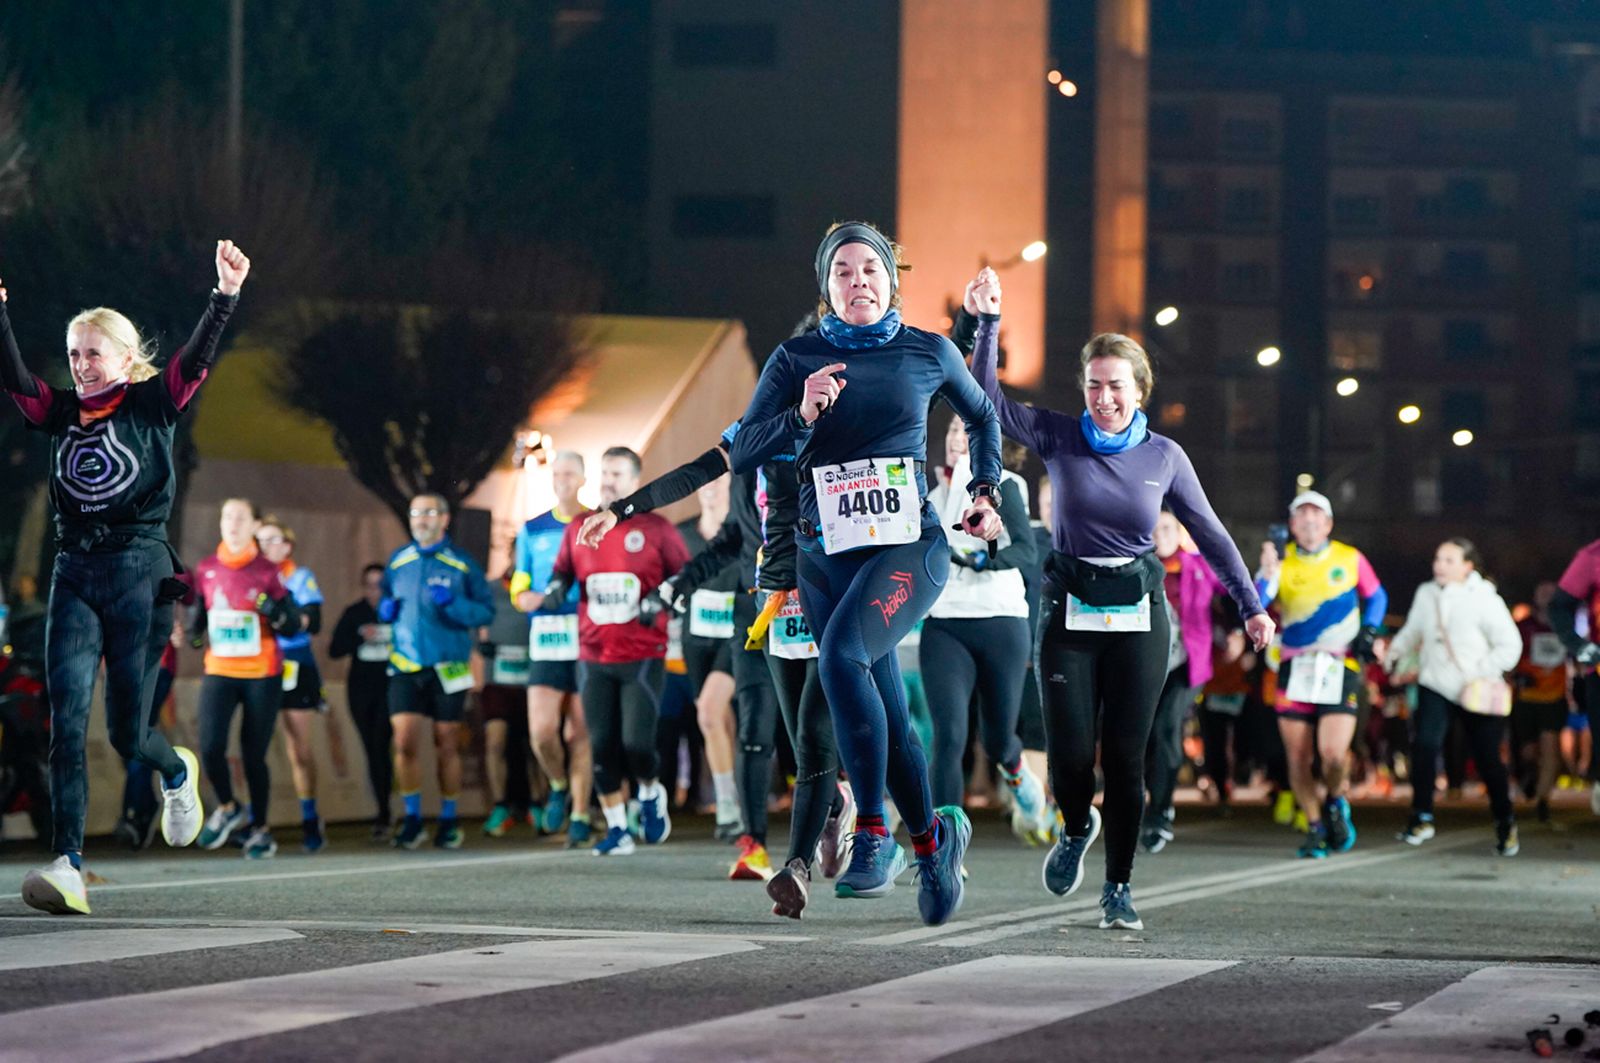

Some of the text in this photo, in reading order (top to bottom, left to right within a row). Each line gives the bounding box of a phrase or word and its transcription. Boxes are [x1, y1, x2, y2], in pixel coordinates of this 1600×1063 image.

[836, 471, 865, 482] NOCHE
[827, 482, 845, 495] SAN
[838, 488, 901, 518] 4408
